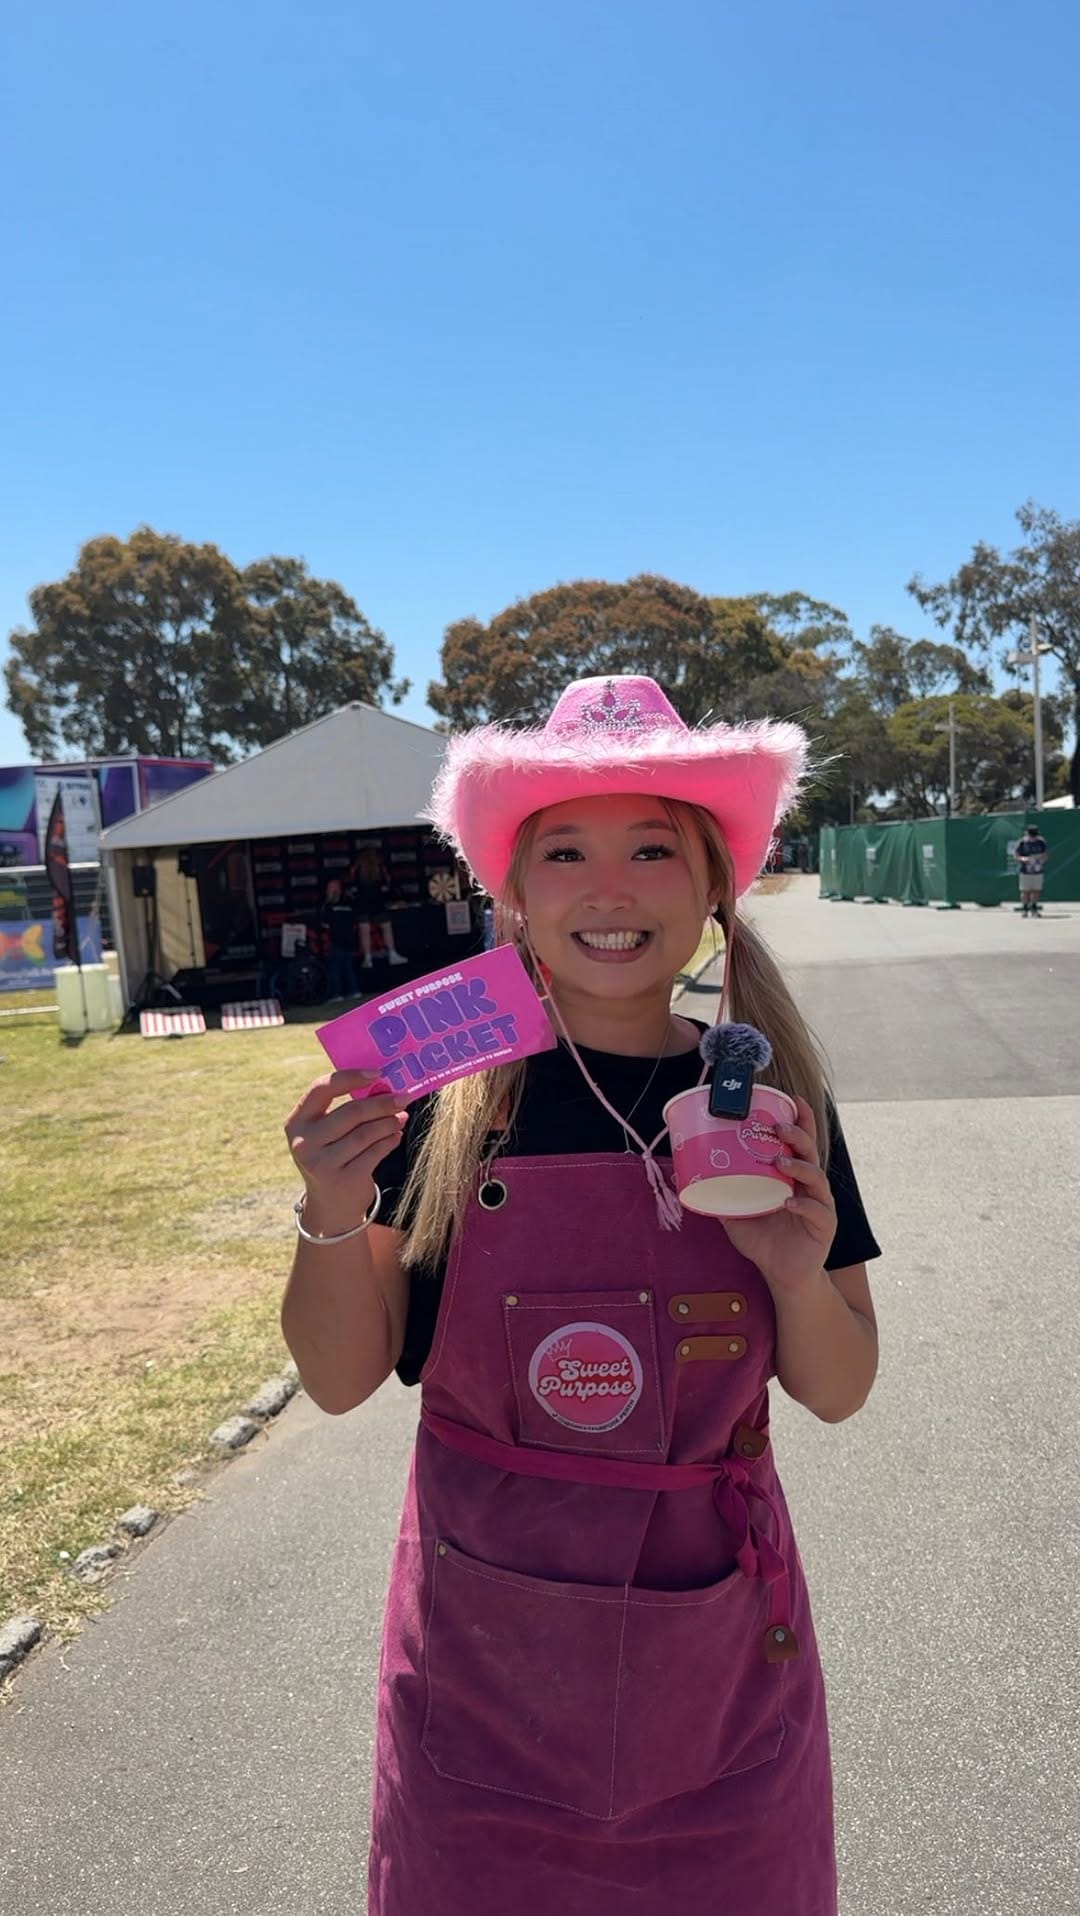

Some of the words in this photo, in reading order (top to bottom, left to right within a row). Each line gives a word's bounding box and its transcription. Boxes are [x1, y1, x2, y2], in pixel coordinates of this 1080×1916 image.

[378, 991, 415, 1015] SWEET
[415, 972, 464, 997] PURPOSE
[368, 977, 497, 1058] PINK
[380, 1013, 519, 1093] TICKET
[538, 1376, 635, 1402] Purpose
[558, 1359, 630, 1380] Sweet
